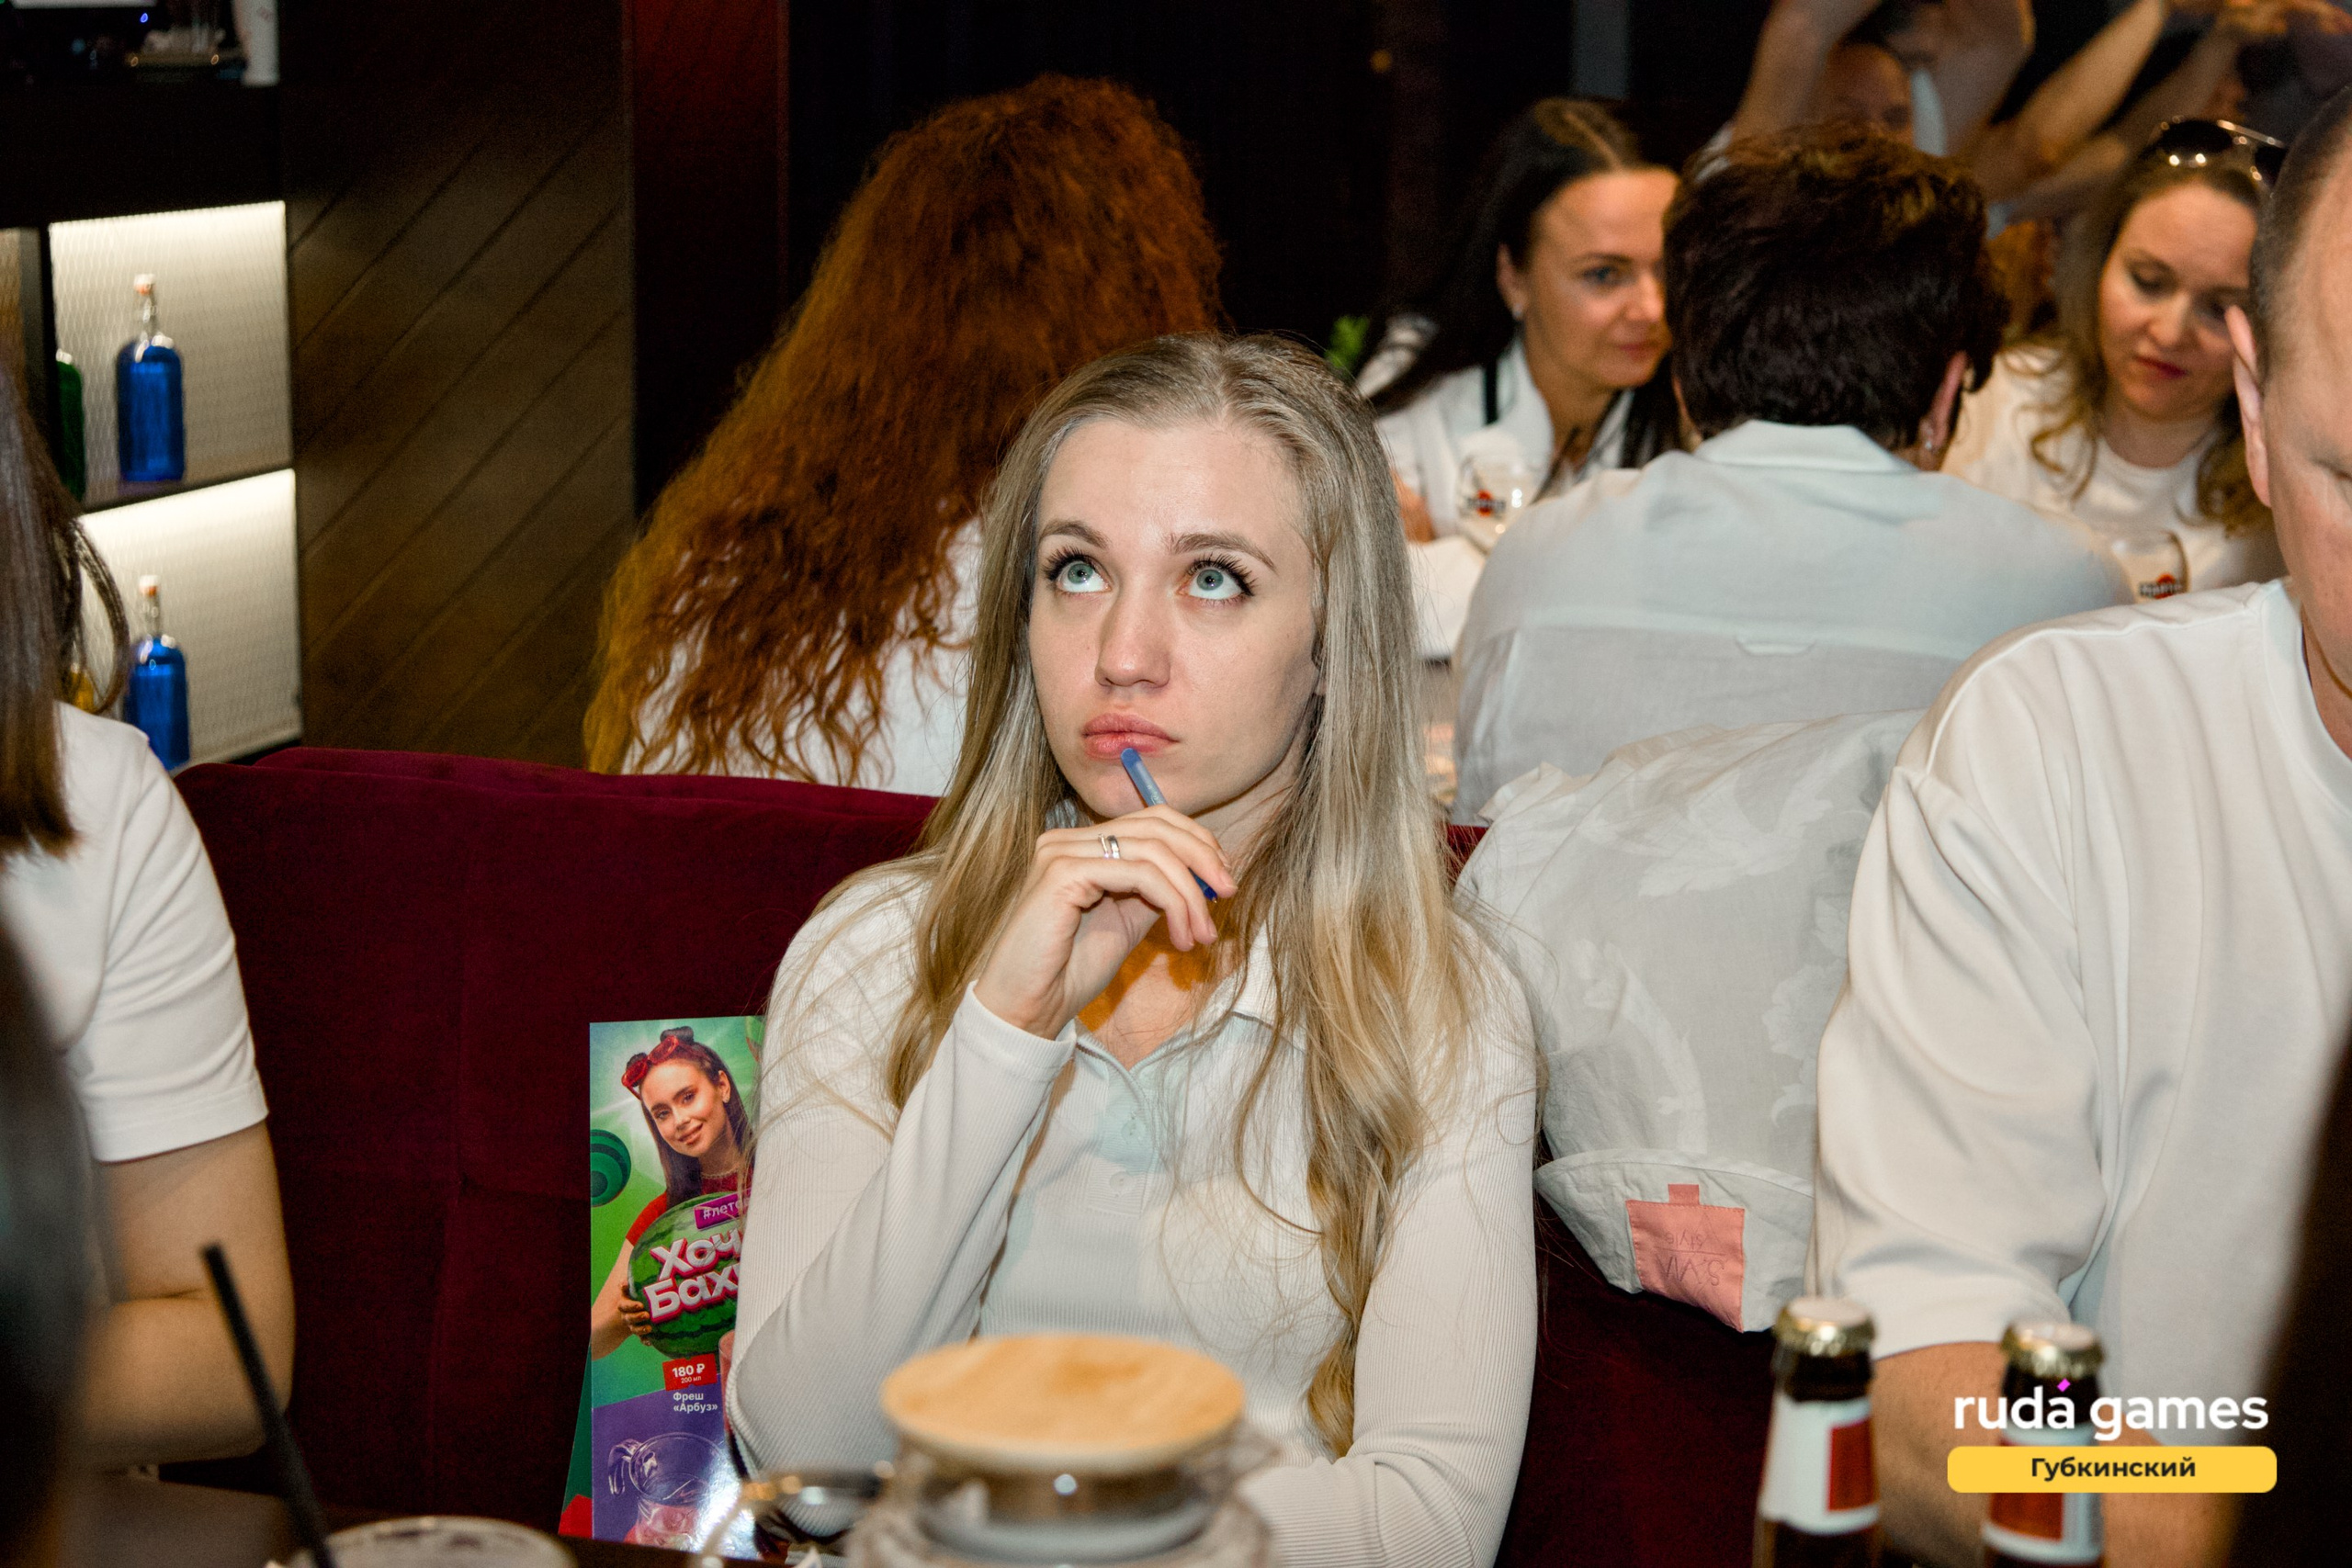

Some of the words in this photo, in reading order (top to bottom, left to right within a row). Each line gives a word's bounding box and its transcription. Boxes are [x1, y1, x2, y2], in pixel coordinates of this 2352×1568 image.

[644, 1263, 741, 1319] Бах
[672, 1365, 695, 1378] 180
[680, 1376, 693, 1384] 200
[673, 1392, 704, 1403] Фреш
[673, 1402, 718, 1415] «Арбуз»
